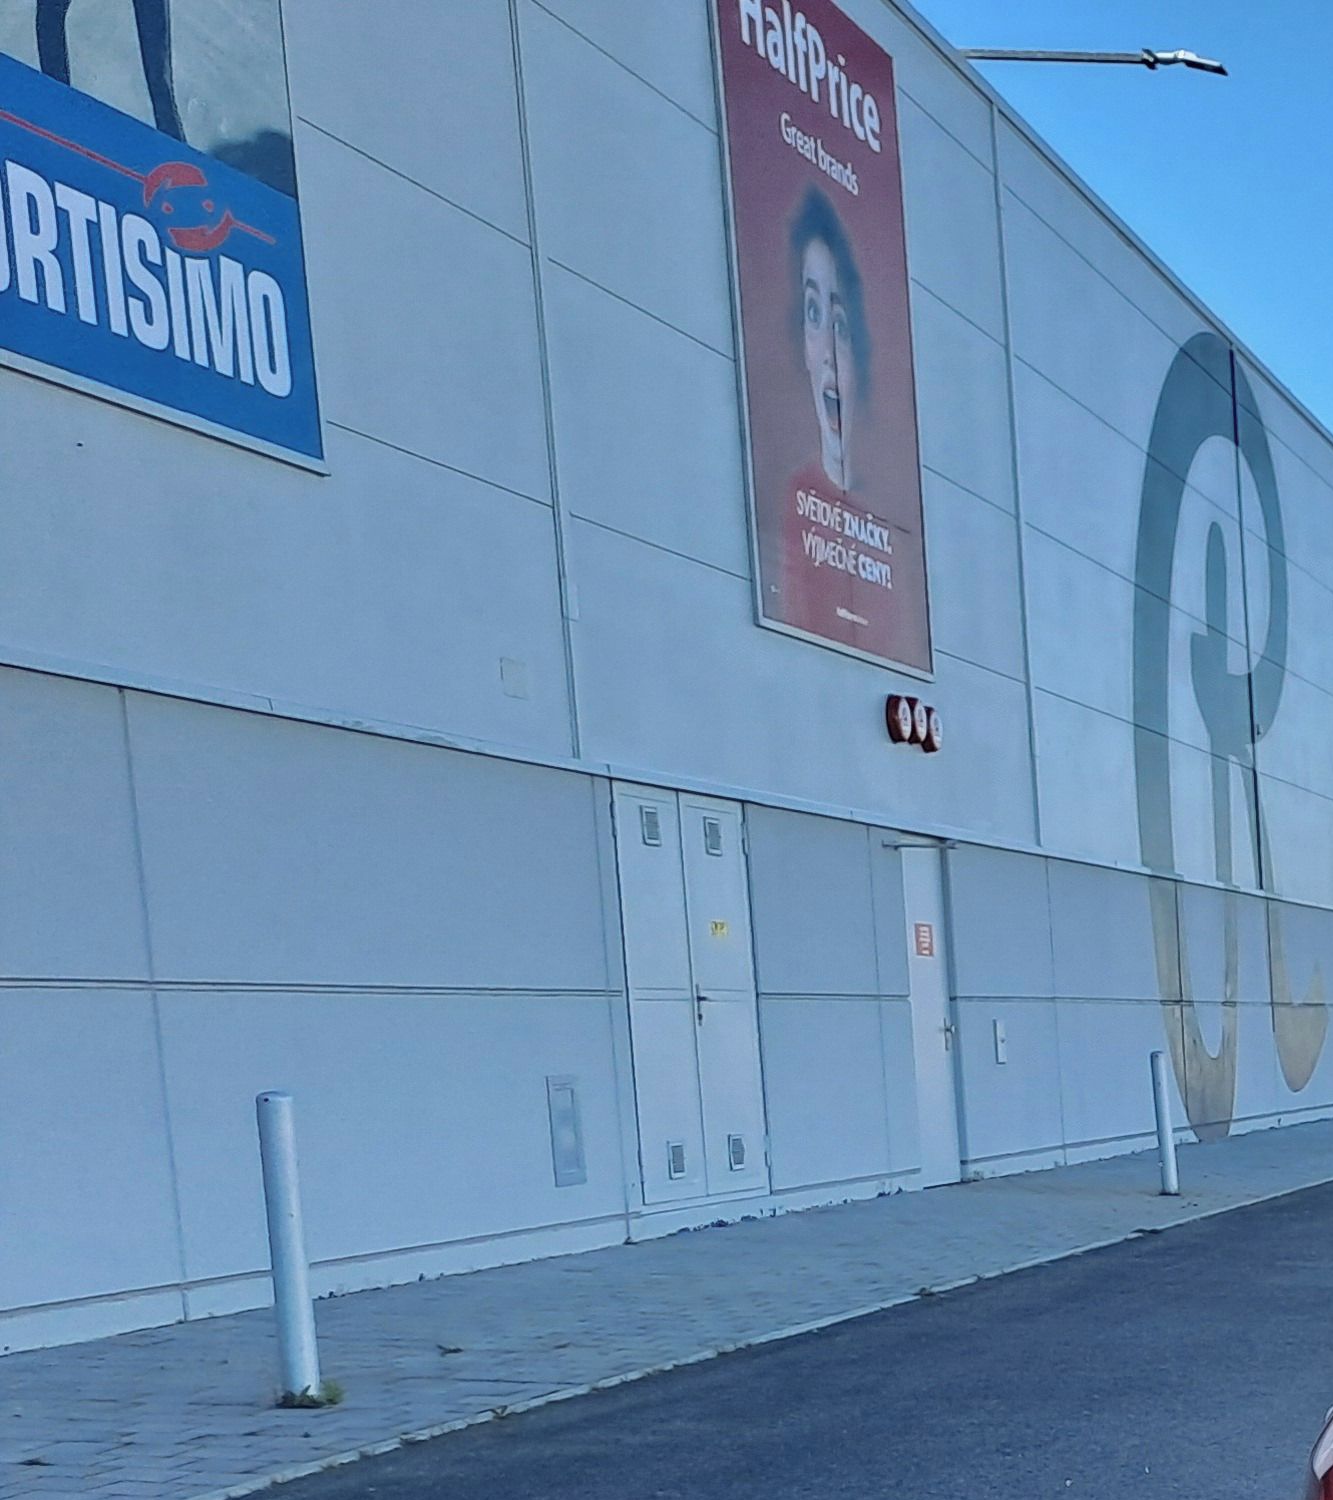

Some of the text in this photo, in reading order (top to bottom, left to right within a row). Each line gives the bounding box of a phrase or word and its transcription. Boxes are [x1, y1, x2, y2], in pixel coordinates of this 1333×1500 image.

[780, 112, 859, 196] Great brands
[0, 159, 292, 398] RTISIMO
[796, 489, 843, 533] SVĚTOVÉ
[857, 553, 892, 590] CENY!
